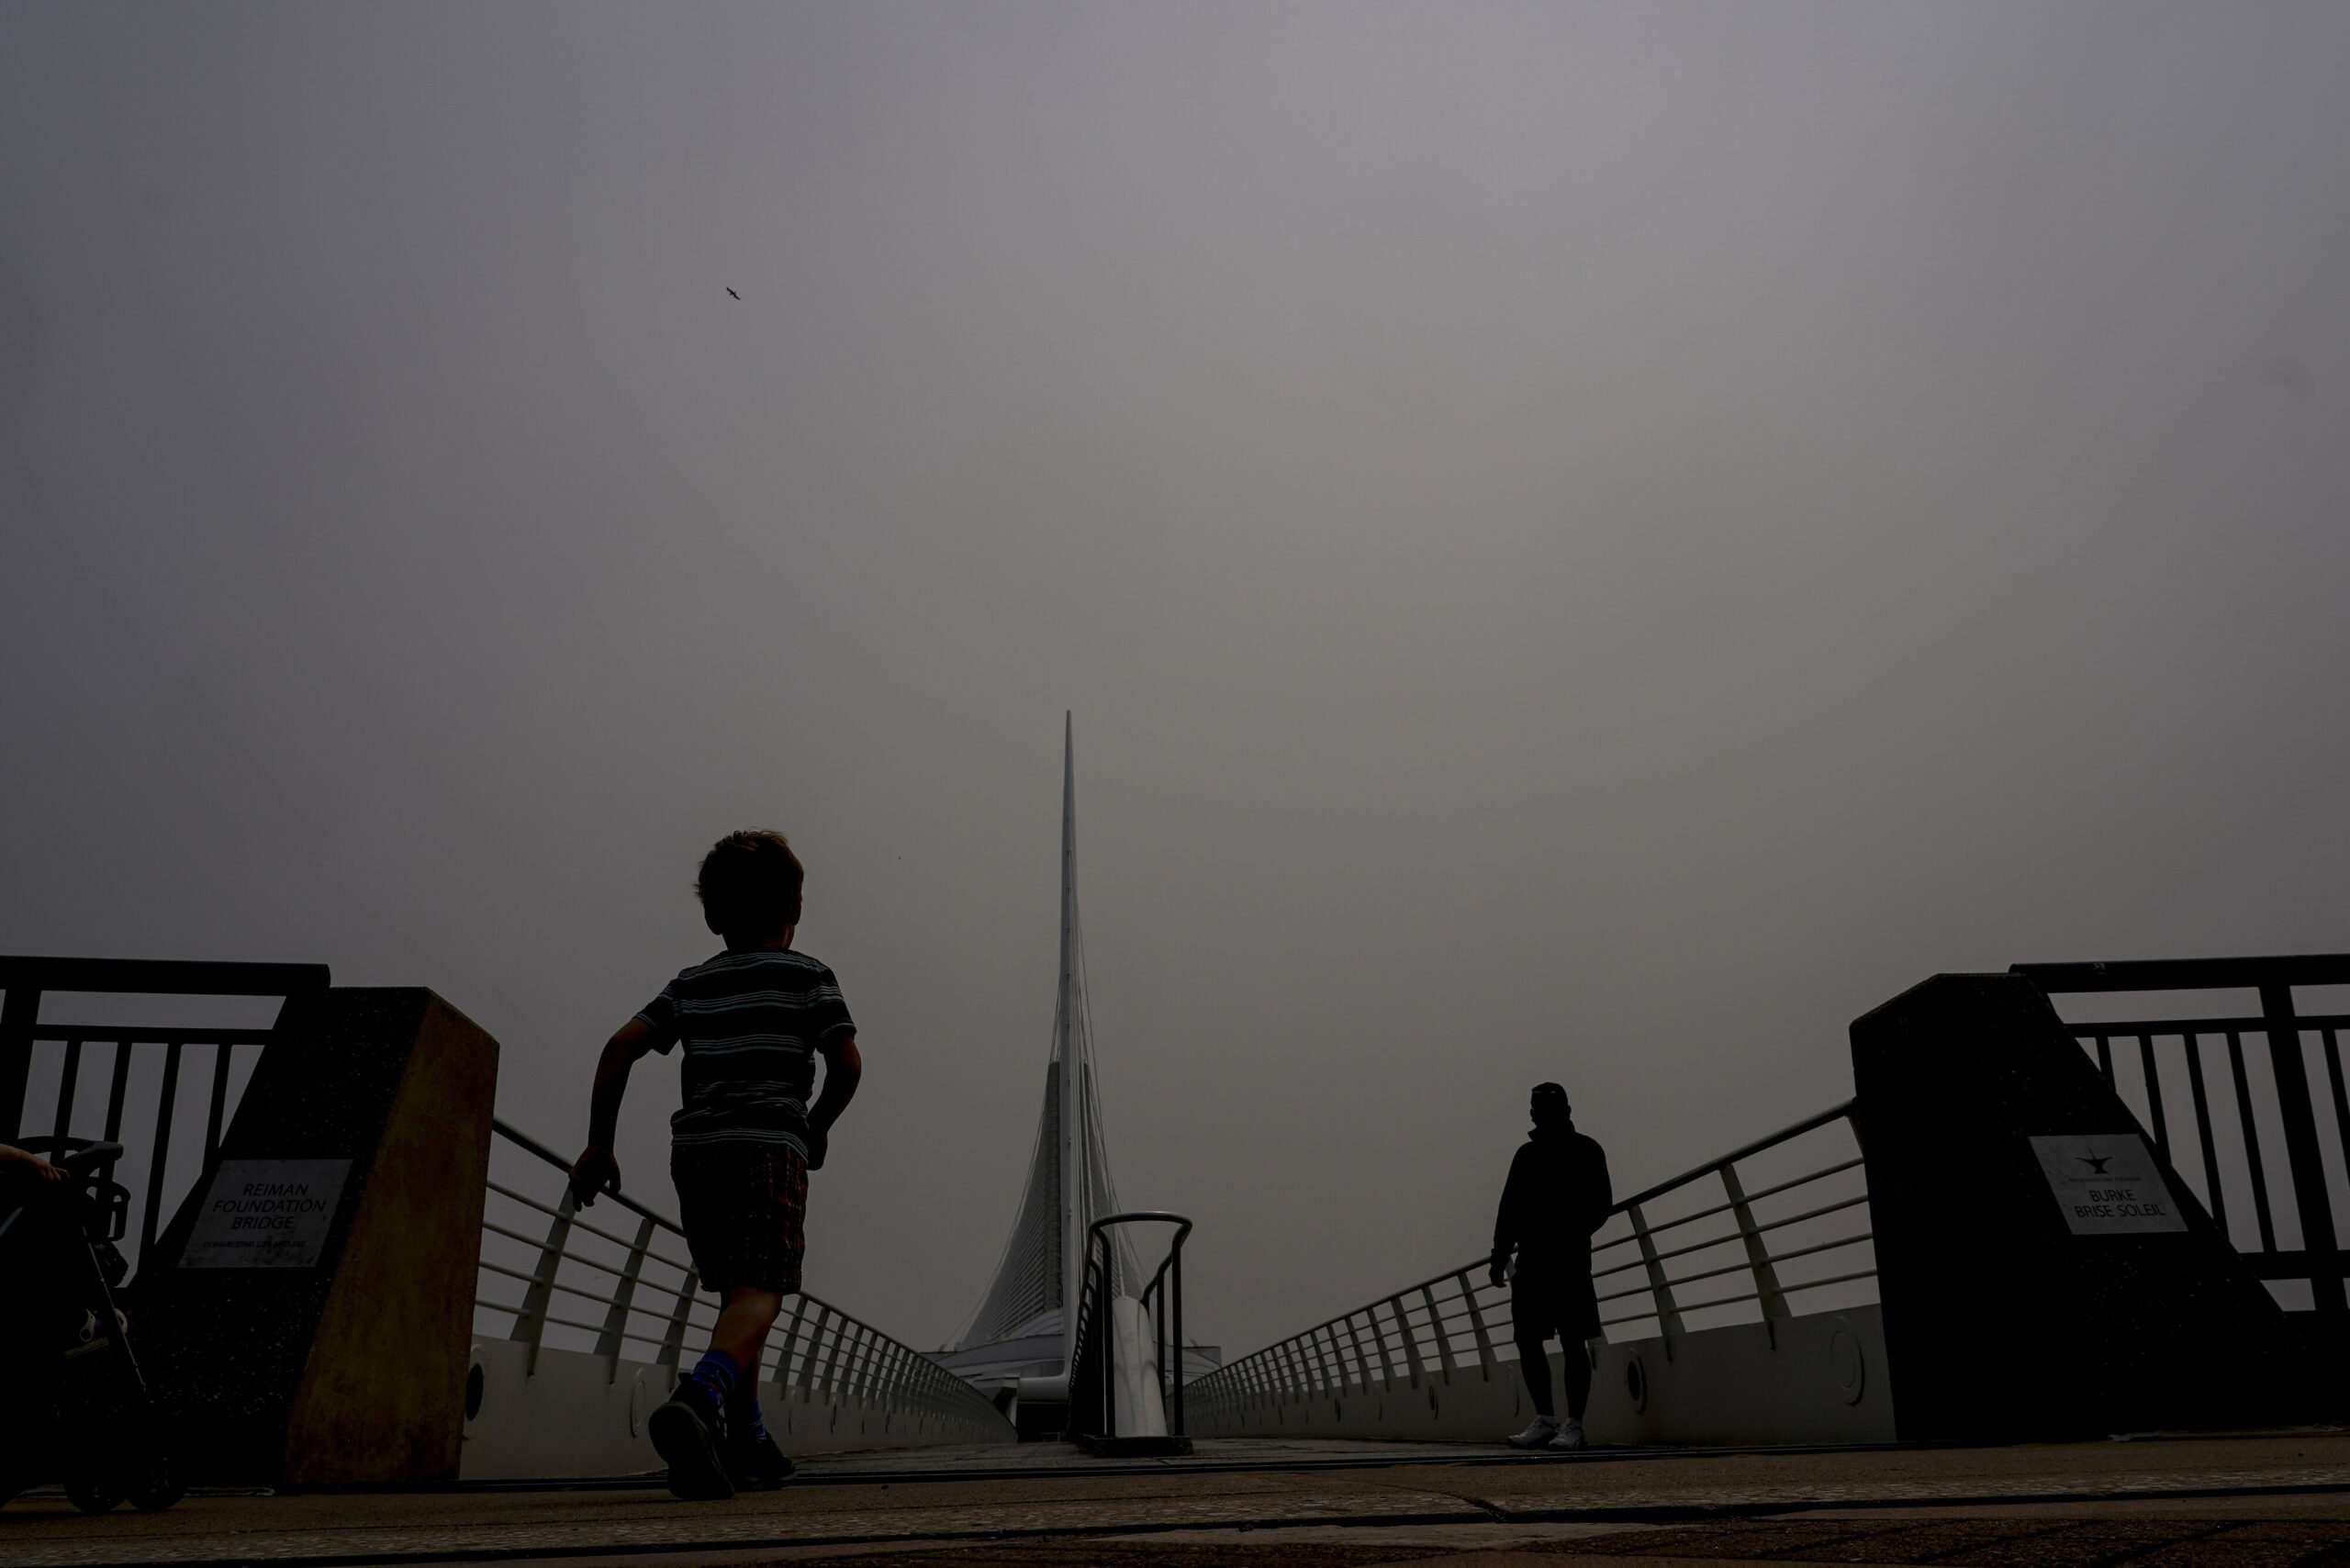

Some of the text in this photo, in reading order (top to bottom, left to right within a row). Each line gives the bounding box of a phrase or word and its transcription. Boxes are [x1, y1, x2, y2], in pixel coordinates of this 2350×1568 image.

[242, 1183, 309, 1196] REIMAN
[2088, 1189, 2137, 1202] BURKE
[212, 1200, 327, 1213] FOUNDATION
[2074, 1204, 2166, 1218] BRISE SOLEIL
[230, 1215, 295, 1230] BRIDGE
